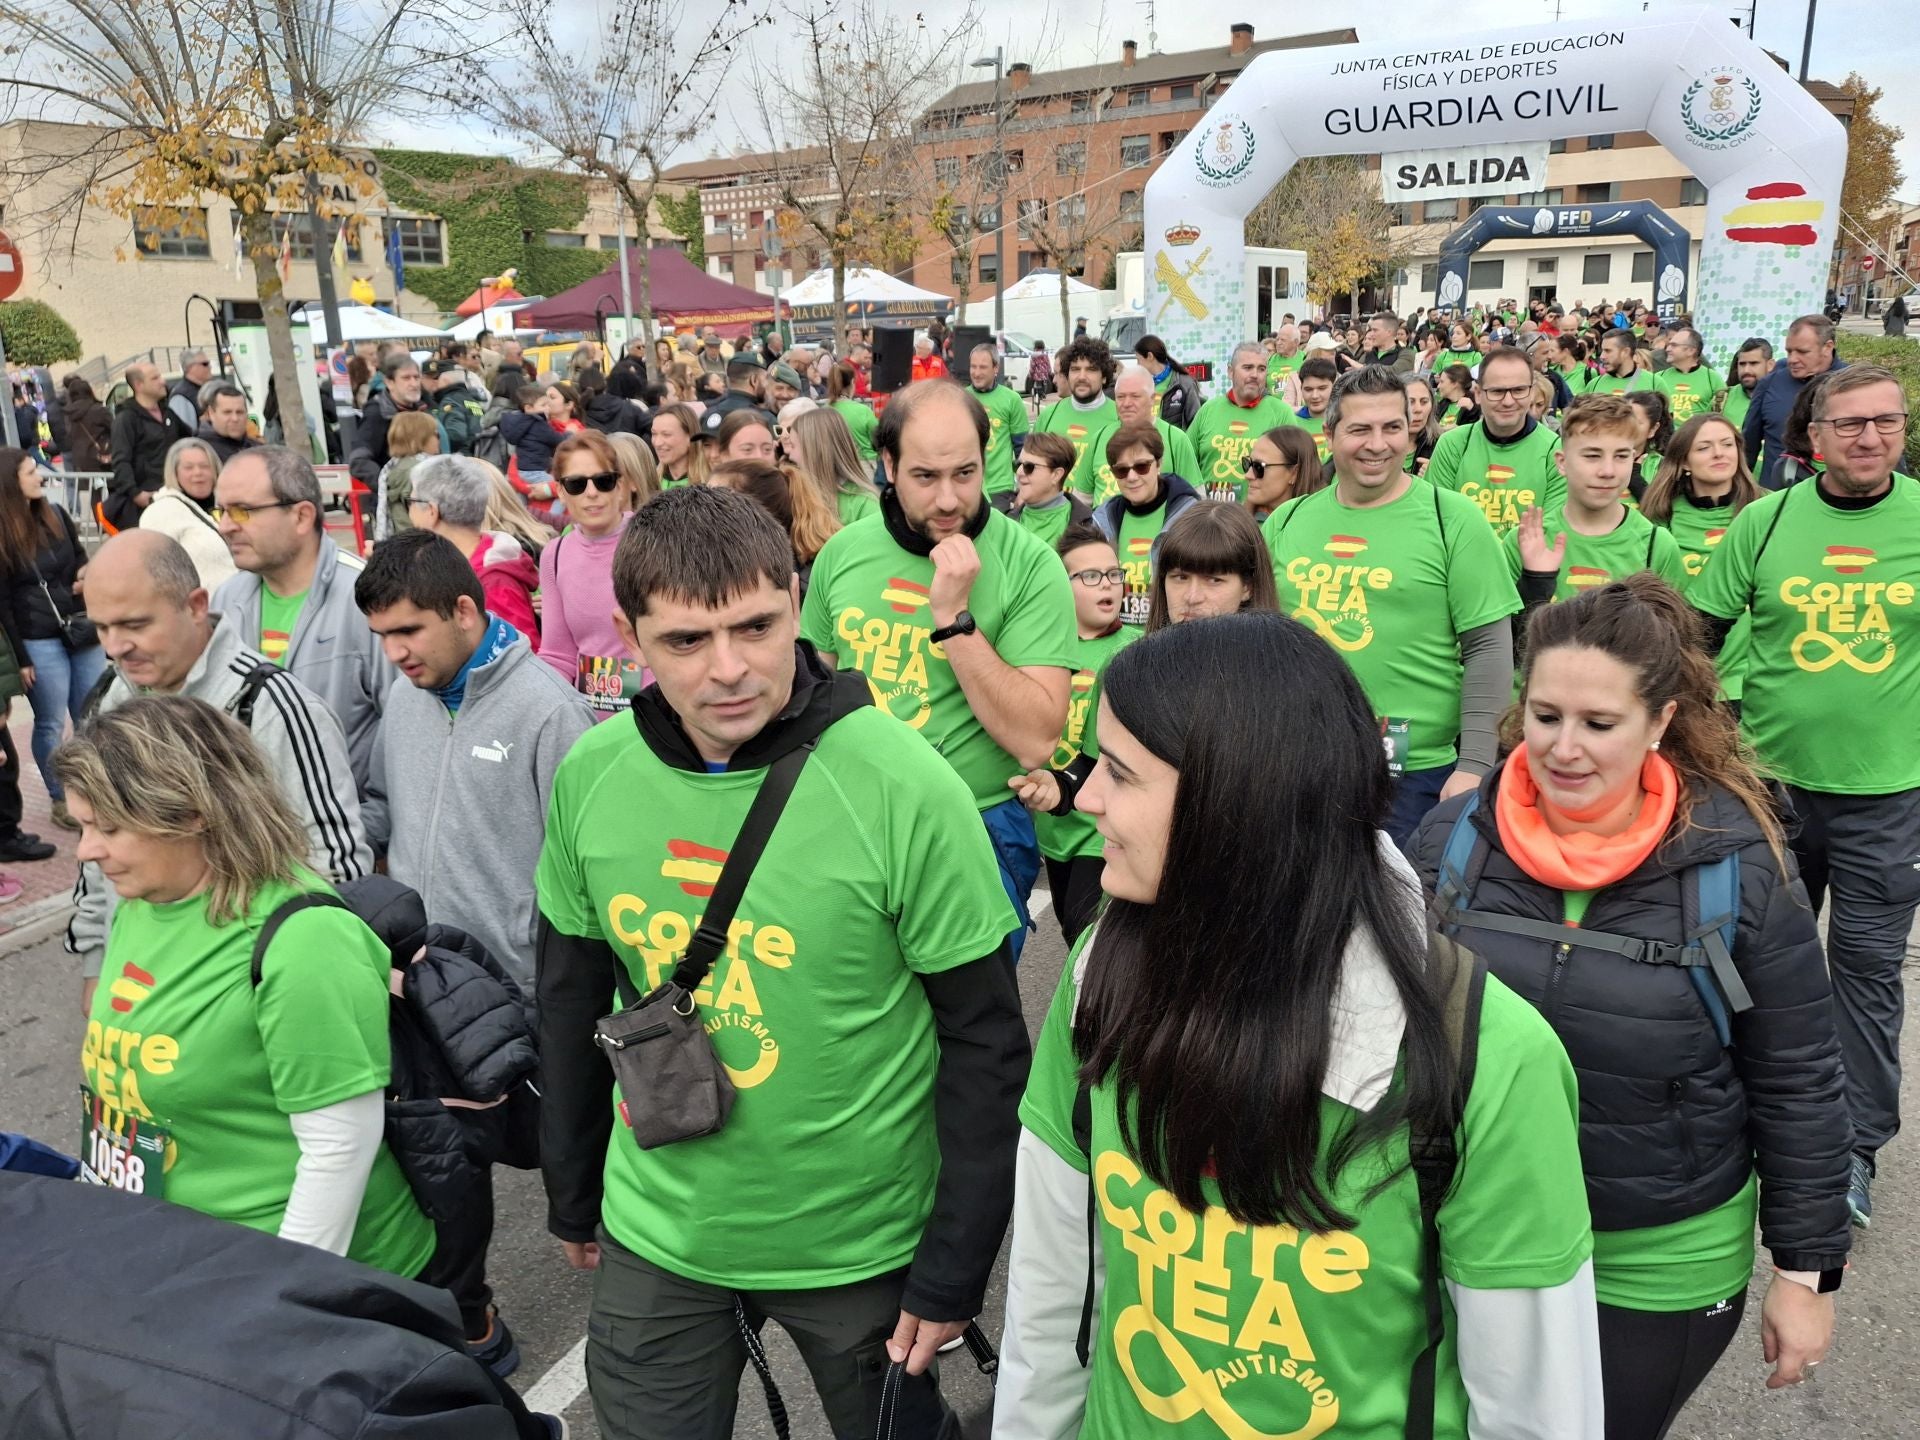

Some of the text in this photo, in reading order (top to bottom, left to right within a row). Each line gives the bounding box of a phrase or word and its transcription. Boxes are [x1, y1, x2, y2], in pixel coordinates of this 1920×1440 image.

[1330, 31, 1625, 76] JUNTA CENTRAL DE EDUCACIÓN
[1383, 59, 1558, 91] FÍSICA Y DEPORTES
[1324, 83, 1619, 136] GUARDIA CIVIL
[1685, 130, 1757, 151] GUARDIA CIVIL
[1195, 169, 1253, 189] GUARDIA CIVIL
[1396, 156, 1531, 190] SALIDA
[1559, 210, 1592, 225] FFD
[1657, 303, 1684, 317] FFD
[1672, 393, 1700, 402] orre
[1460, 481, 1535, 506] Corre
[1286, 556, 1393, 590] Corre
[1295, 580, 1368, 614] TEA
[1780, 576, 1915, 606] Corre
[1330, 612, 1374, 634] AUTISMO
[1797, 603, 1891, 633] TEA
[1847, 632, 1897, 651] AUTISMO
[850, 639, 929, 689] TEA
[585, 672, 622, 697] 349
[887, 684, 932, 711] AUTISMO
[703, 1011, 777, 1051] AUTISMO
[84, 1020, 180, 1075] orre
[90, 1129, 144, 1194] 1058
[1095, 1150, 1370, 1293] Corre
[1123, 1229, 1316, 1362] TEA
[1213, 1353, 1335, 1408] AUTISMO
